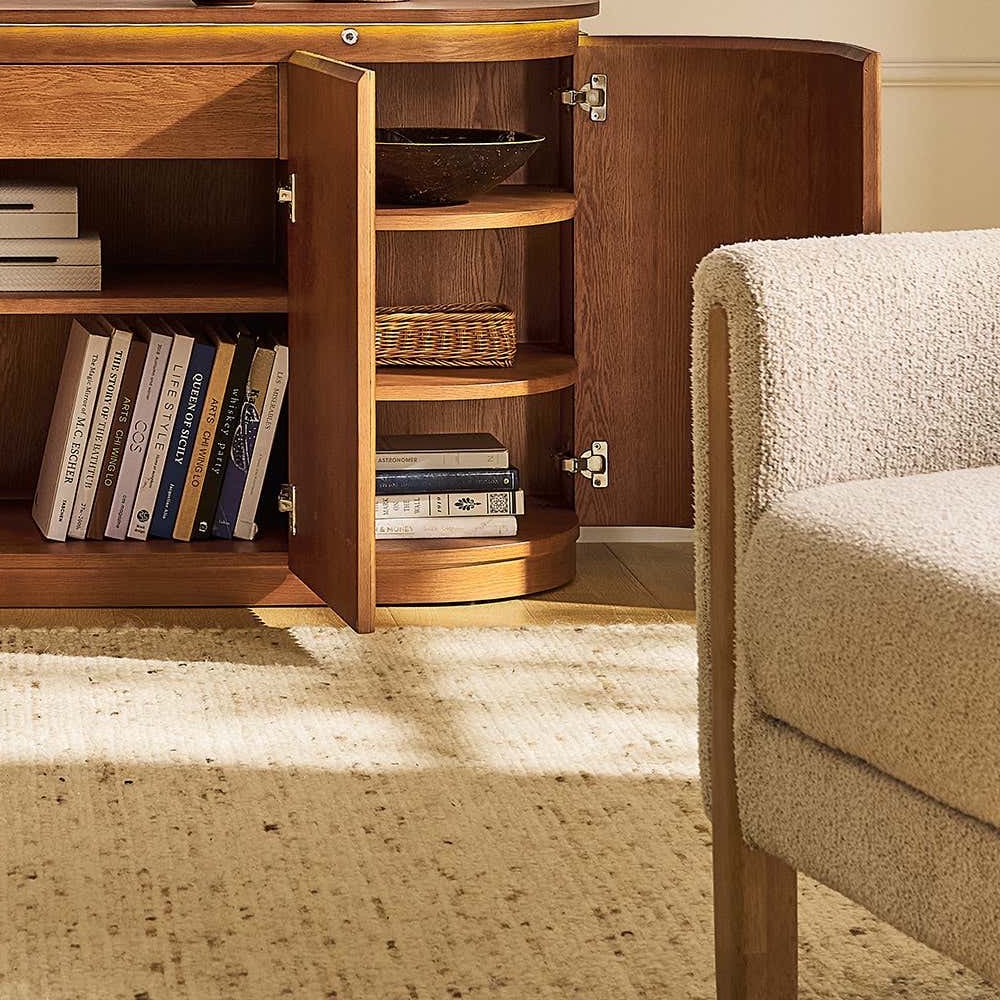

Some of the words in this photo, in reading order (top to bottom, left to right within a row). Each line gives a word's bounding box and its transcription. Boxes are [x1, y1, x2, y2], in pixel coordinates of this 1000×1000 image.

[90, 354, 99, 366] The
[111, 350, 123, 371] THE
[86, 366, 96, 385] Magic
[82, 386, 92, 407] Mirror
[104, 372, 117, 405] STORY
[187, 373, 203, 411] QUEEN
[80, 407, 87, 415] of
[100, 406, 109, 420] OF
[118, 396, 131, 422] ARTS
[183, 412, 193, 428] OF
[206, 397, 219, 424] ARTS
[220, 388, 239, 436] whiskey
[72, 416, 86, 439] M.C.
[94, 421, 107, 442] THE
[113, 429, 124, 446] CHI
[129, 420, 147, 453] COS
[200, 430, 211, 447] CHI
[174, 428, 190, 464] SICILY
[64, 442, 81, 483] ESCHER
[84, 443, 101, 488] BATHTUB
[107, 447, 120, 472] WING
[194, 448, 207, 473] WING
[211, 442, 226, 474] party
[104, 473, 114, 486] LO
[191, 474, 201, 487] LO
[58, 499, 67, 522] TASCHEN
